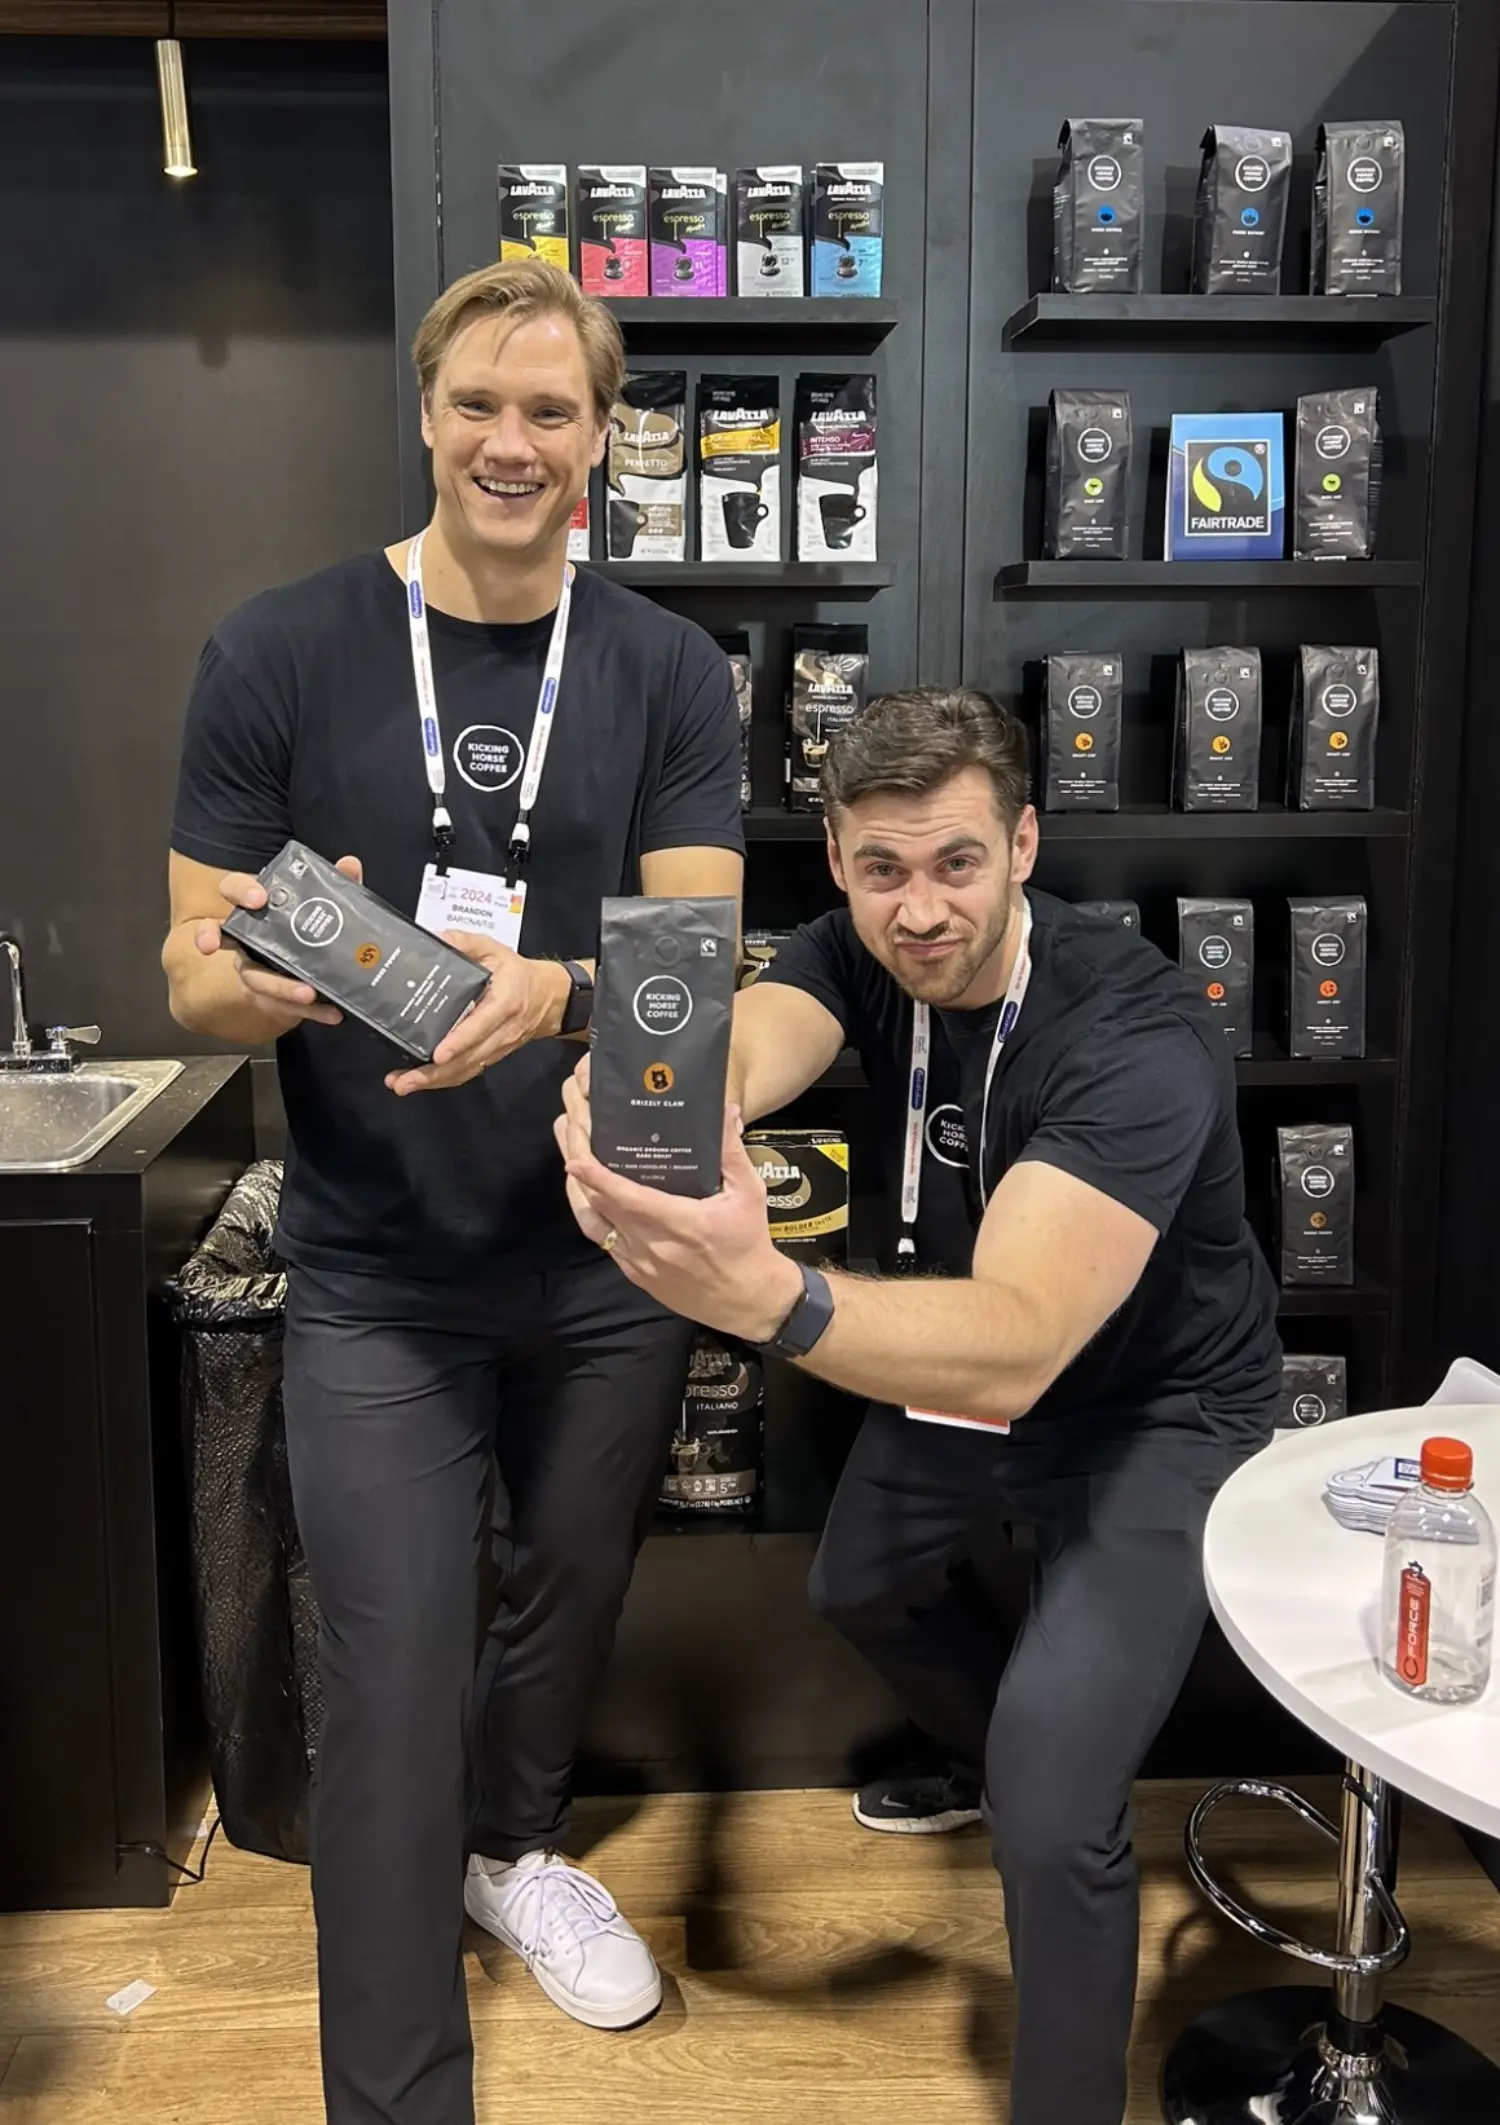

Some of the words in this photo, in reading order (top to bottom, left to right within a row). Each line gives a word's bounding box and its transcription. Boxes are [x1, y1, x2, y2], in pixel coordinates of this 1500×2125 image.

[510, 182, 555, 196] LAVAZZA
[590, 184, 635, 198] LAVAZZA
[661, 185, 706, 199] LAVAZZA
[747, 183, 792, 198] LAVAZZA
[827, 181, 872, 195] LAVAZZA
[512, 211, 555, 222] espresso
[592, 214, 634, 224] espresso
[663, 215, 705, 225] espresso
[749, 212, 791, 222] espresso
[828, 211, 870, 221] espresso
[712, 407, 769, 421] LAVAZZA
[810, 408, 866, 422] LAVAZZA
[1191, 516, 1265, 529] FAIRTRADE
[808, 682, 853, 694] LAVAZZA
[805, 704, 855, 714] espresso
[467, 742, 510, 754] KICKING
[472, 753, 506, 763] HORSE
[469, 762, 508, 773] COFFEE
[460, 887, 493, 904] 2024
[452, 903, 494, 918] BRANDON
[646, 993, 681, 1002] KICKING
[649, 1001, 677, 1010] HORSE
[647, 1010, 679, 1019] COFFEE
[630, 1098, 661, 1107] GRIZZLY
[663, 1100, 685, 1108] CLAW
[940, 1119, 966, 1132] KICK
[942, 1129, 968, 1143] HOR
[939, 1136, 969, 1152] COFF
[758, 1161, 800, 1179] AZZA
[767, 1195, 803, 1207] esso
[686, 1384, 739, 1398] presso
[696, 1401, 739, 1411] ITALIANO
